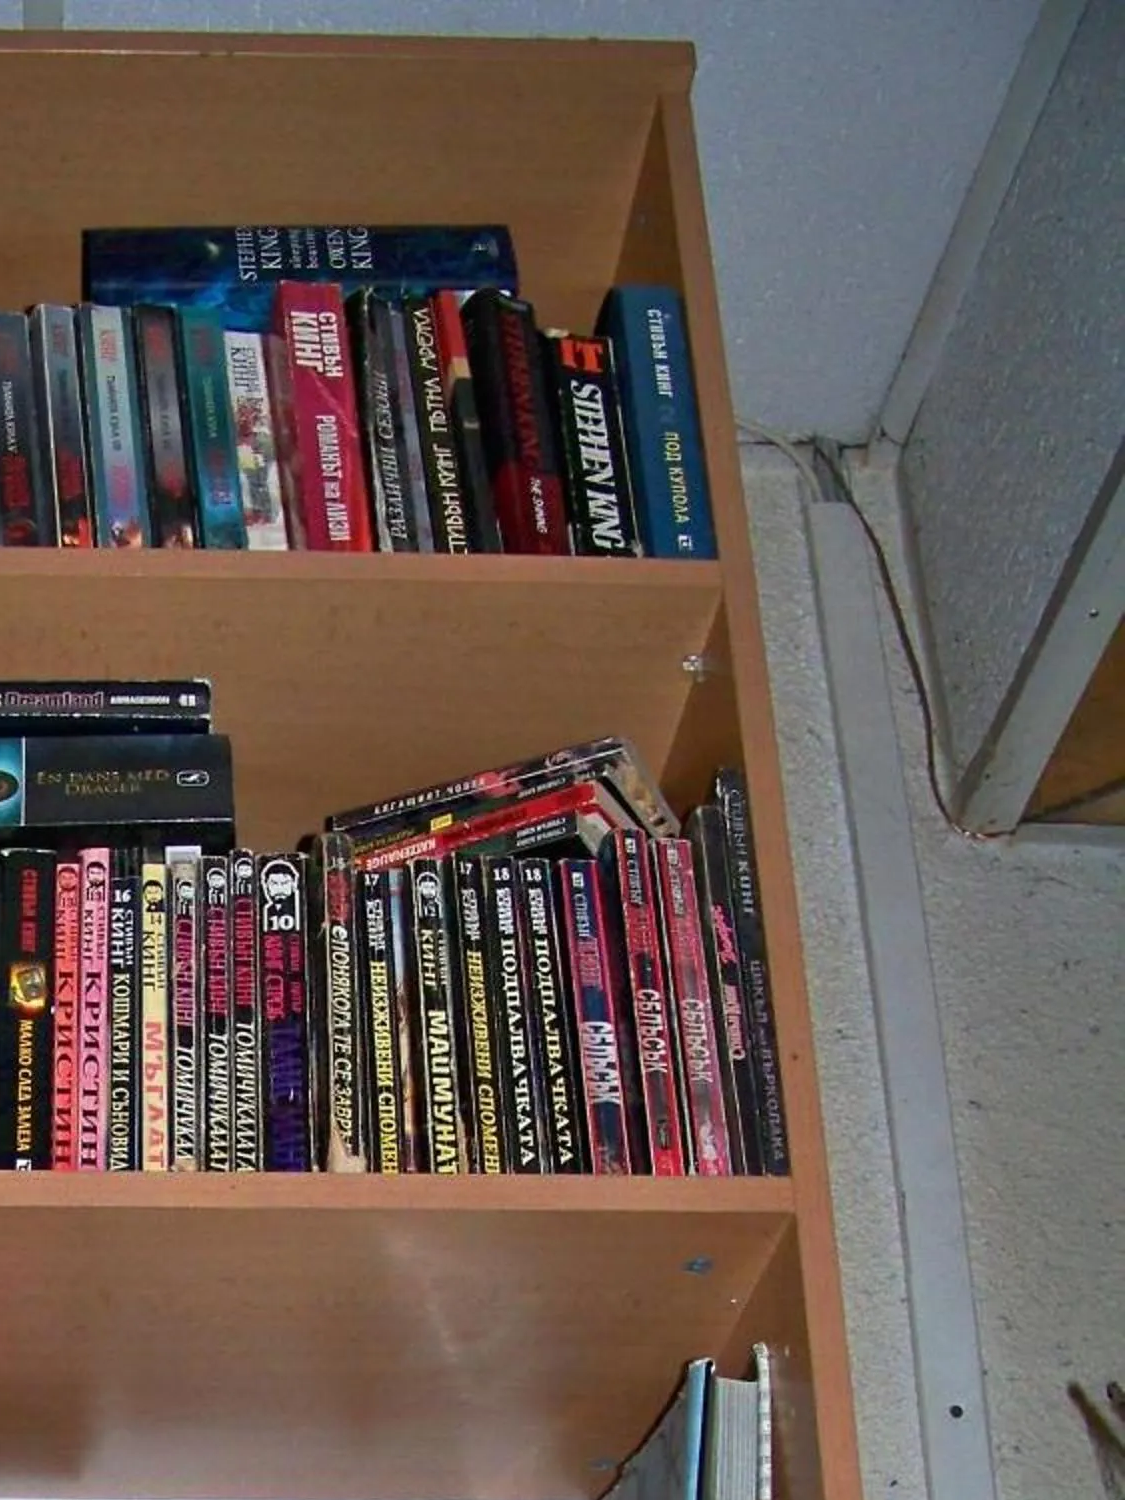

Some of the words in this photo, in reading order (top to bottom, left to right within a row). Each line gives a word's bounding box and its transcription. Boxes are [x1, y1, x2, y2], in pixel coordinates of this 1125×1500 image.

[260, 229, 283, 269] KING
[349, 228, 373, 269] KING
[290, 311, 323, 372] КИНГ
[317, 311, 345, 378] СТИВЪН
[560, 338, 605, 375] IT
[645, 309, 666, 362] СТИВЪН
[371, 369, 396, 440] СЕЗОНИ
[654, 363, 674, 399] КИНГ
[315, 414, 343, 480] РОМАНЪТ
[569, 380, 615, 486] STEPHEN
[662, 432, 680, 463] ПОД
[322, 482, 337, 499] на
[378, 446, 408, 540] РАЗЛИЧНИ
[585, 488, 627, 550] KING
[666, 466, 692, 526] КУПОЛА
[326, 501, 351, 542] ЛИЗИ
[364, 837, 437, 871] KATZENAUGE
[493, 868, 512, 883] 18
[524, 868, 544, 883] 18
[114, 889, 132, 904] 16
[266, 915, 294, 931] 10
[81, 908, 94, 964] КИНГ
[110, 907, 125, 968] КИНГ
[235, 897, 255, 962] СТИВЪН
[142, 929, 156, 992] КИНГ
[332, 938, 352, 1031] ПОНЯКОГА
[18, 1020, 34, 1066] МАЛКО
[112, 972, 131, 1065] КОШМАРИ
[369, 960, 393, 1088] НЕИЗЖИВЕНИ
[466, 948, 492, 1079] НЕИЗЖИВЕНИ
[635, 988, 668, 1073] СБЛЪСЪК
[680, 997, 714, 1084] СБЛЪСЪК
[55, 969, 77, 1167] КРИСТИН
[80, 969, 102, 1169] КРИСТИН
[334, 1034, 352, 1054] ТЕ
[334, 1057, 352, 1081] СЕ
[500, 938, 536, 1165] ПОДПАЛВАЧКАТА
[533, 937, 574, 1164] ПОДПАЛВАЧКАТА
[582, 1020, 621, 1105] СБЛЪСЪК
[18, 1068, 33, 1101] СЛЕД
[113, 1068, 129, 1081] И
[17, 1104, 33, 1151] ЗАЛЕЗА
